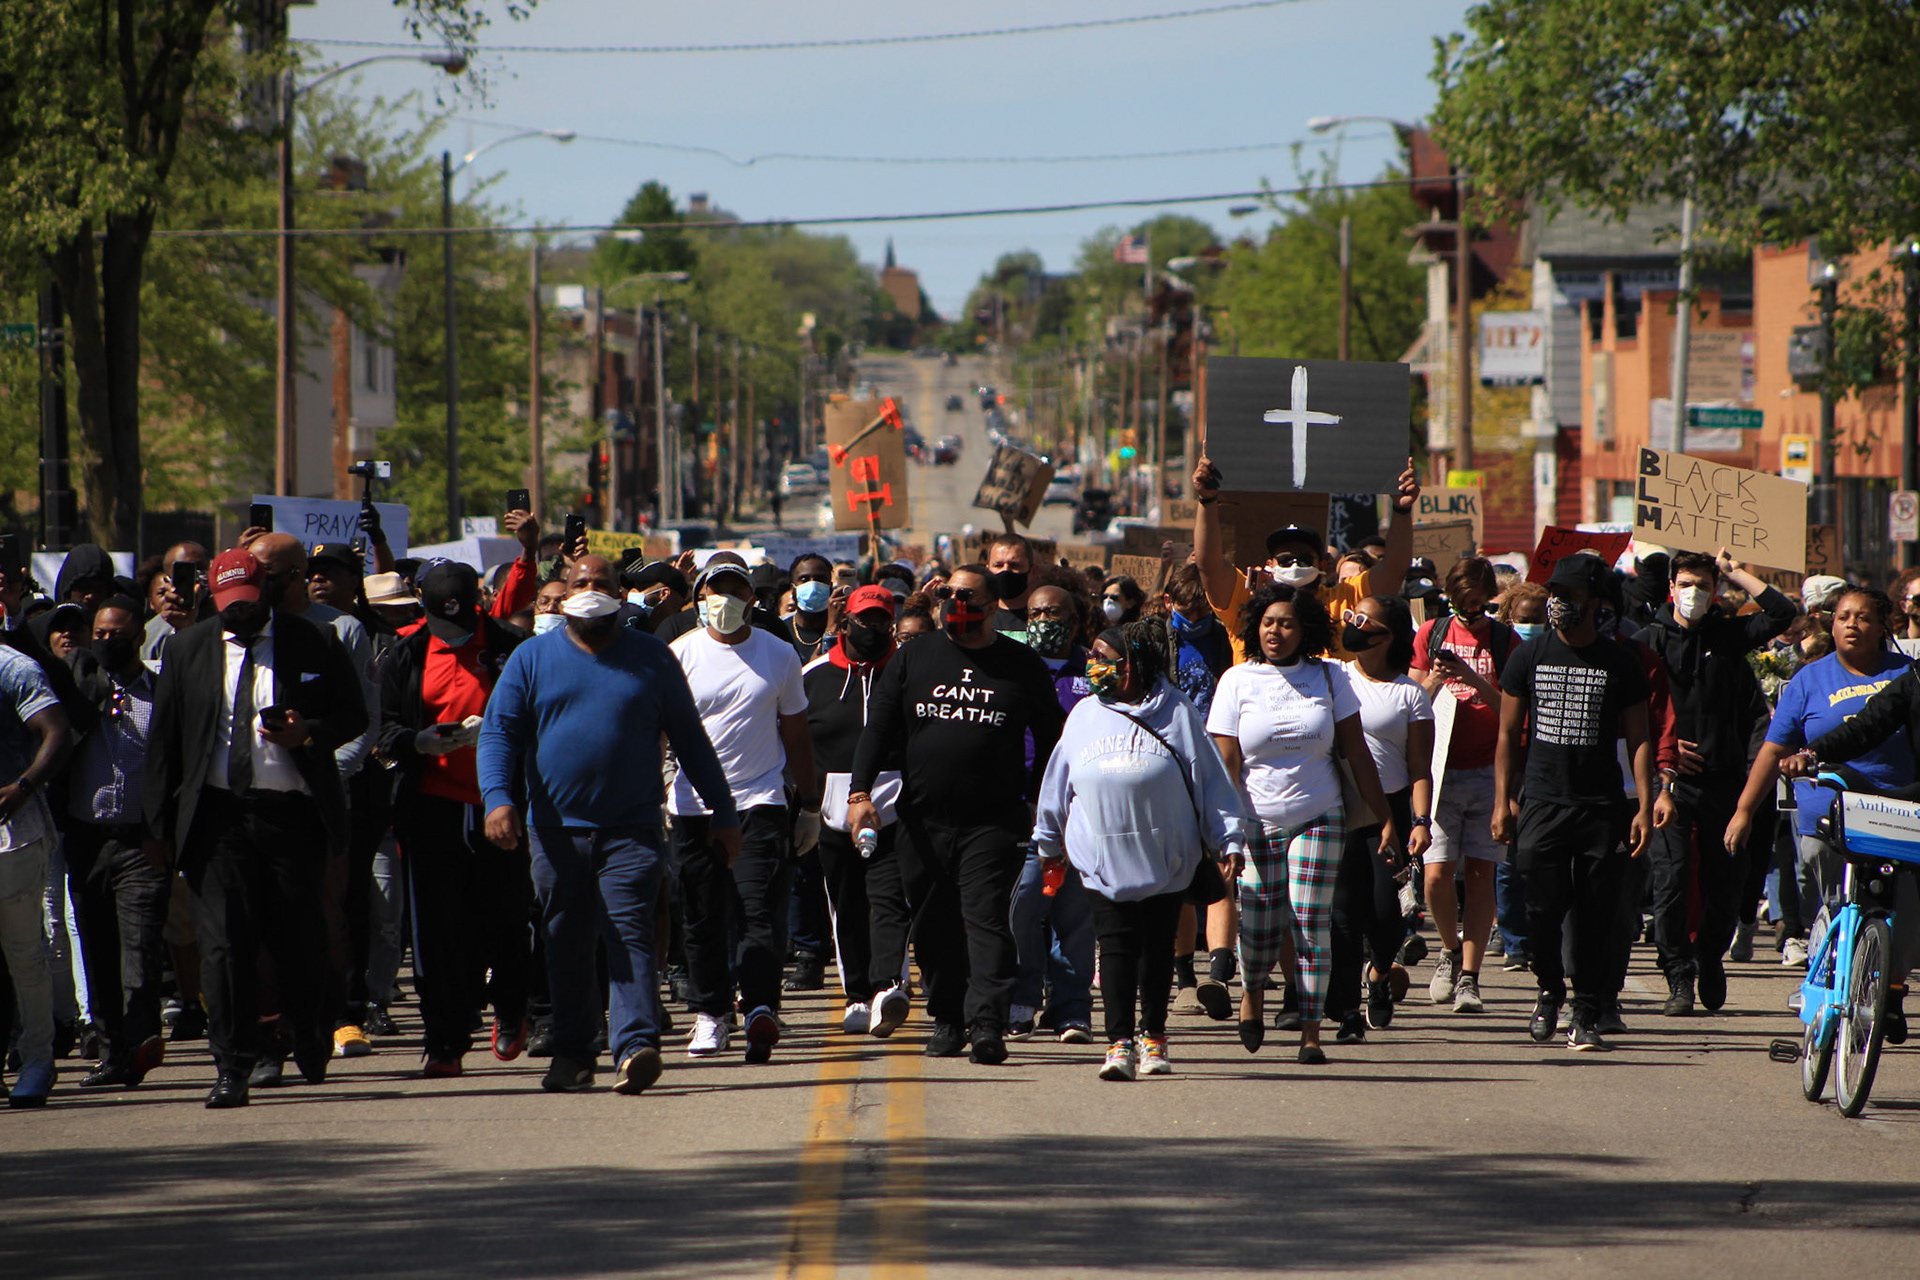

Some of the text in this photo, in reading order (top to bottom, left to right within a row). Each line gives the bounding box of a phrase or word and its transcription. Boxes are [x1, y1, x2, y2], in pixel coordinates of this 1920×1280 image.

[1640, 448, 1757, 502] BLACK
[1420, 495, 1477, 516] BLACK
[1639, 477, 1759, 525] LIVES
[1637, 504, 1770, 552] MATTER
[313, 544, 325, 557] P
[1411, 557, 1423, 567] M
[216, 567, 246, 582] ALUMNUS
[961, 668, 973, 682] I
[1536, 665, 1608, 677] HUMANIZE BEING BLACK
[1535, 673, 1607, 685] HUMANIZE BEING BLACK
[932, 684, 995, 703] CAN'T
[1535, 682, 1605, 694] HUMANIZE BEING BLACK
[1565, 693, 1583, 701] BEING
[1564, 701, 1583, 710] BEING
[916, 702, 1007, 727] BREATHE
[1563, 710, 1582, 718] BEING
[1562, 718, 1581, 727] BEING
[1080, 733, 1169, 767] MINNEAPOLIS
[1855, 797, 1911, 818] Anthem
